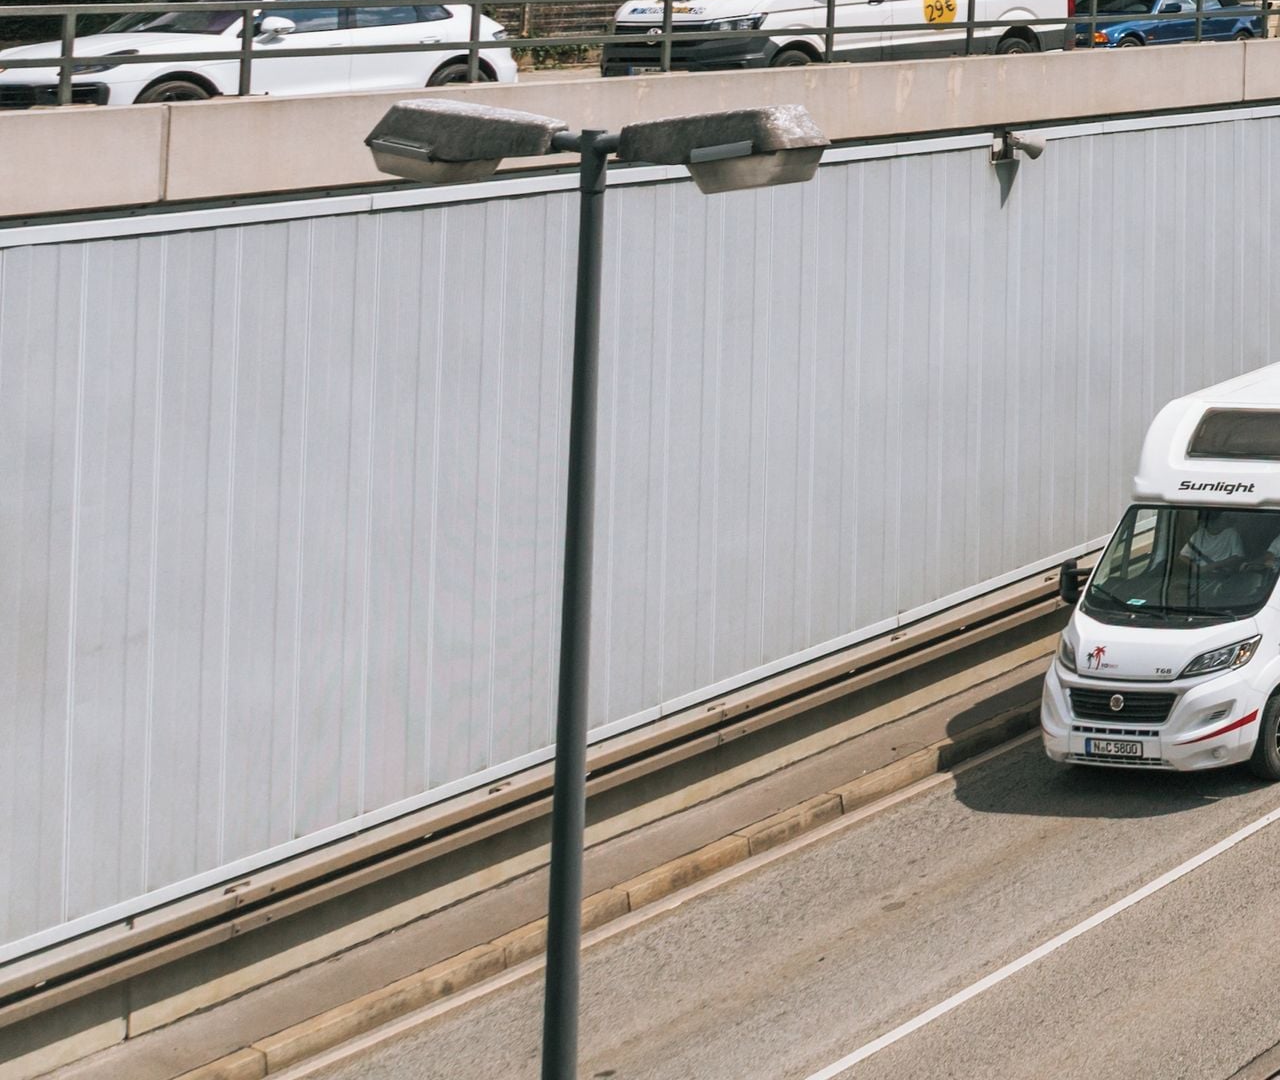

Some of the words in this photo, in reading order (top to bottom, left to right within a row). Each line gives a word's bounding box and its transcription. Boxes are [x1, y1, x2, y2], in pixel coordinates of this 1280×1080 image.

[1178, 480, 1256, 495] Sunlight
[1094, 741, 1100, 752] N
[1113, 743, 1138, 754] 5800
